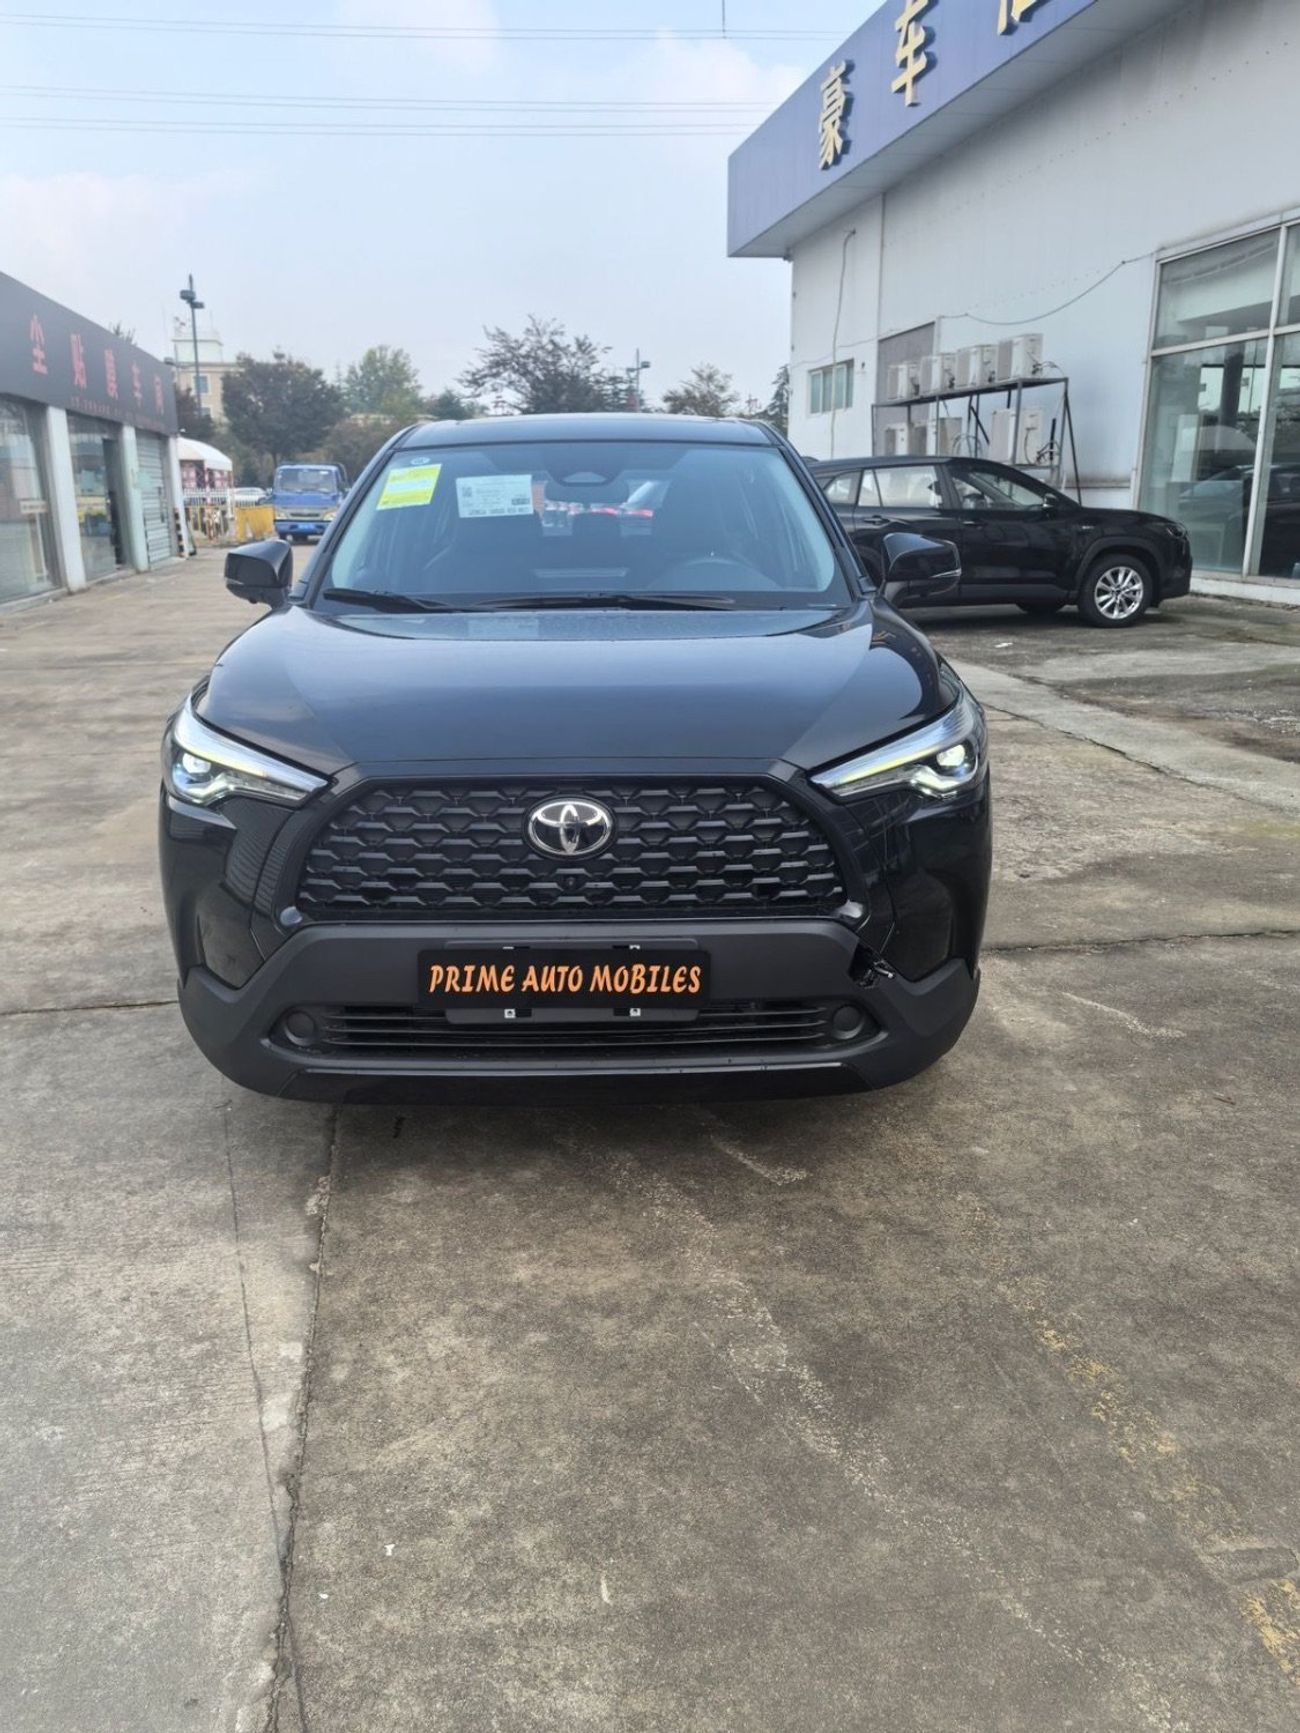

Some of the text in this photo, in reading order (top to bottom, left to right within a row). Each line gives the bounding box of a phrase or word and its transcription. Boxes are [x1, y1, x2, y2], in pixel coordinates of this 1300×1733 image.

[819, 0, 1047, 170] 豪车
[429, 963, 701, 994] PRIME AUTO MOBILES
